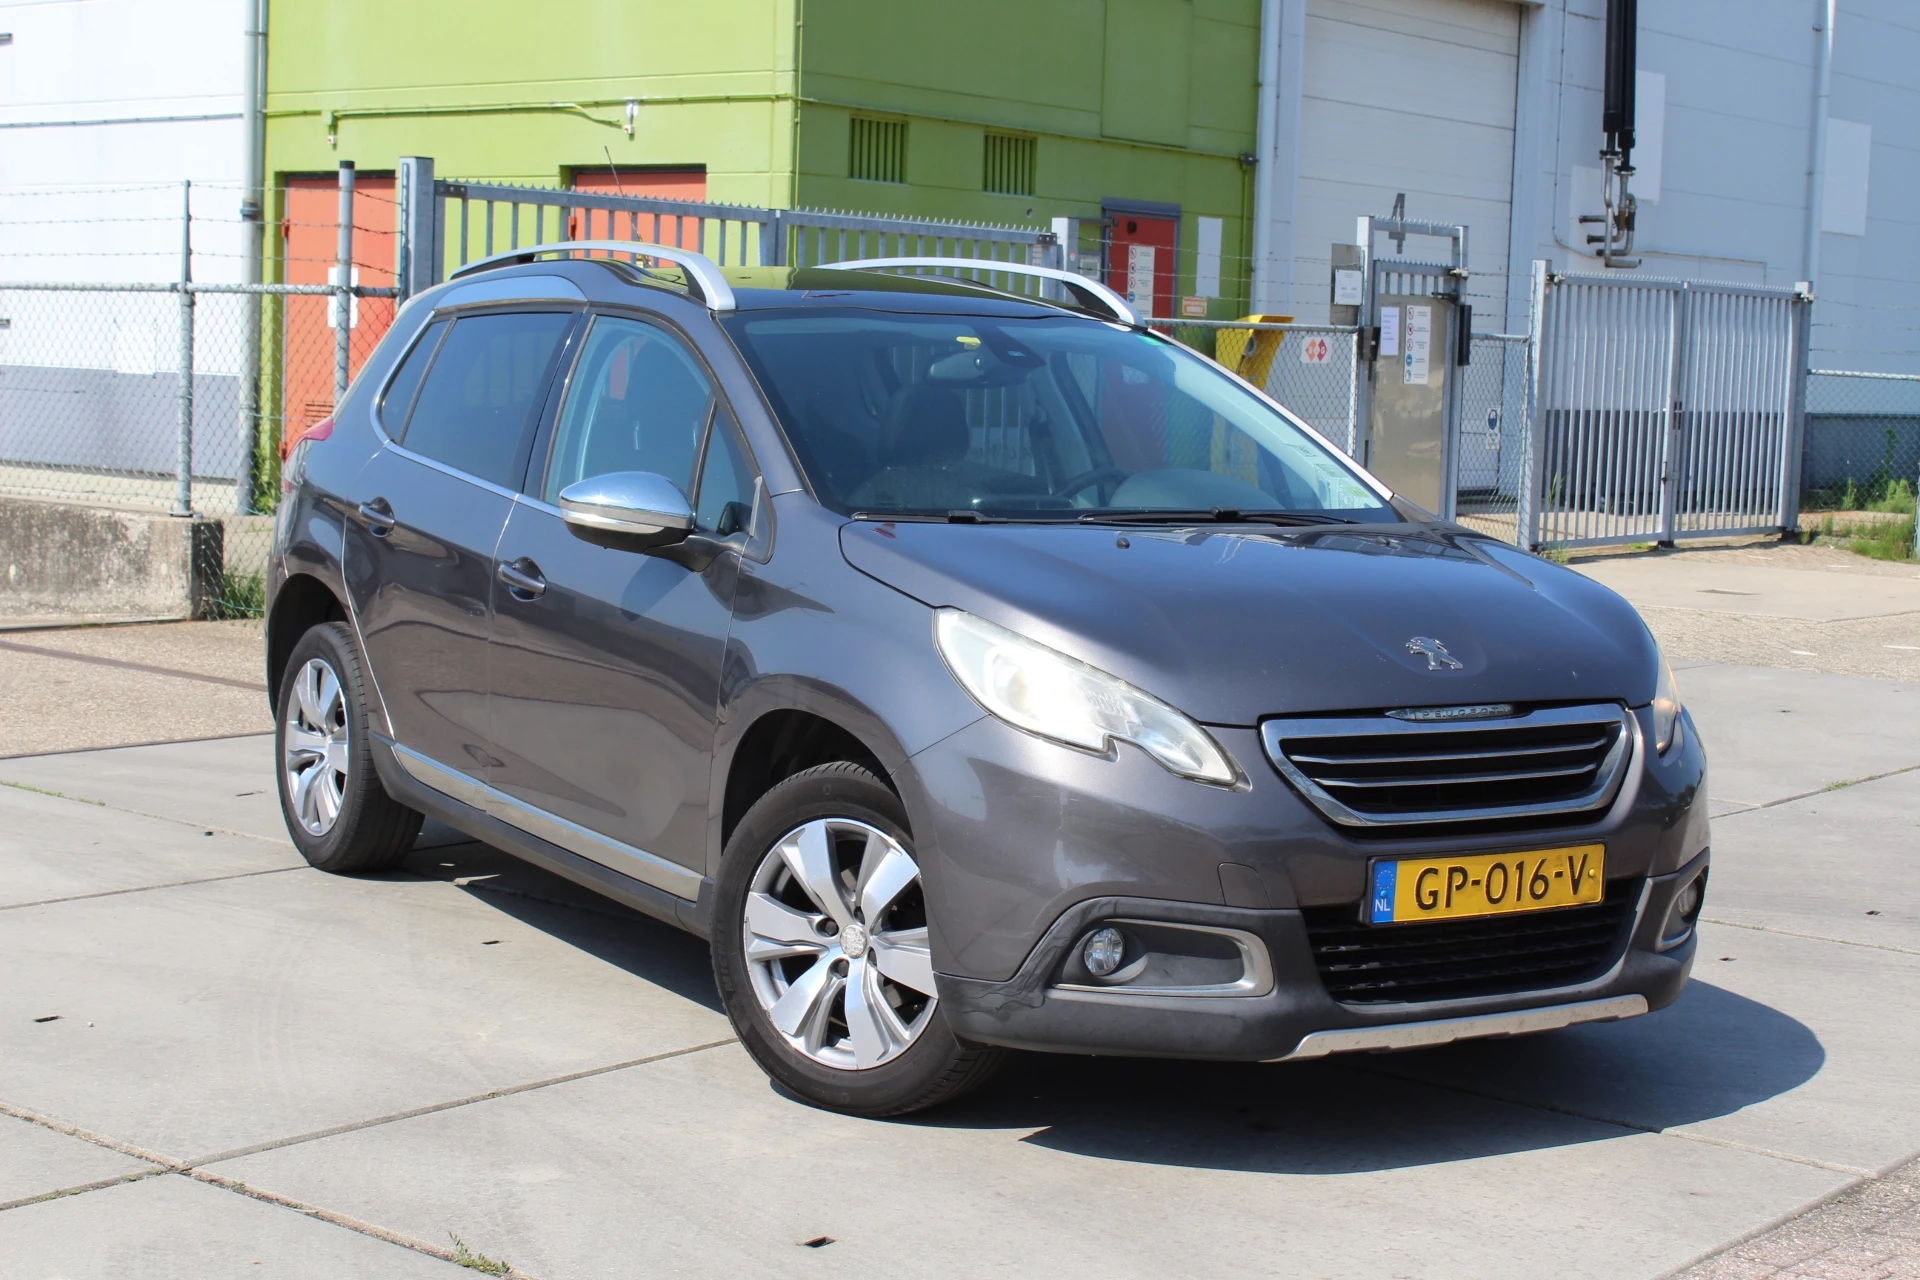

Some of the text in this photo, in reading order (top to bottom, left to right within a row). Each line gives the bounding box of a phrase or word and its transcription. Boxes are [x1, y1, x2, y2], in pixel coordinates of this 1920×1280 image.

[1388, 193, 1406, 254] 4
[1421, 706, 1500, 719] PEUGEOT
[1414, 853, 1589, 911] GP-016-V
[1374, 898, 1391, 912] NL
